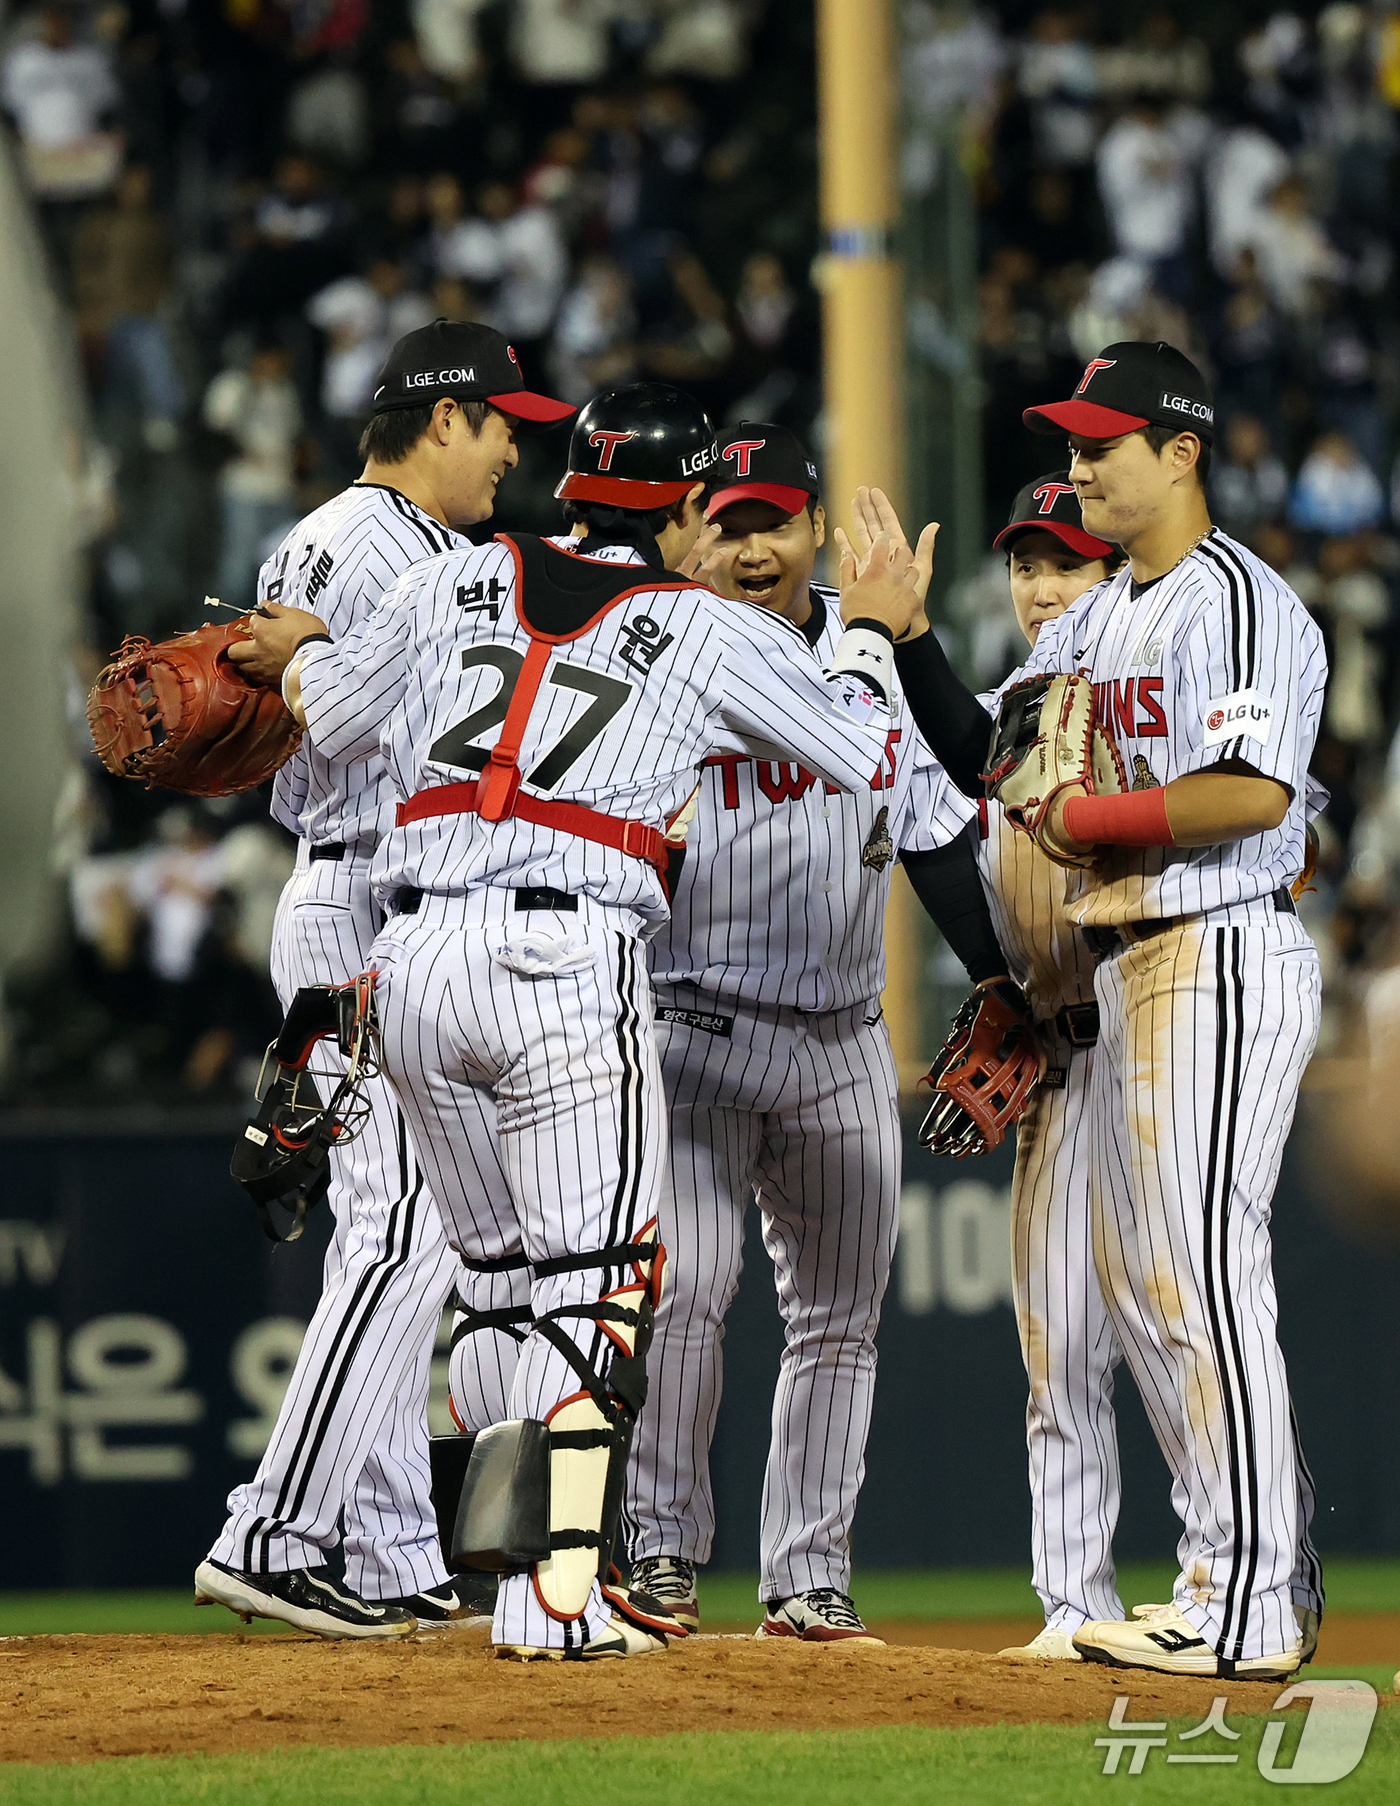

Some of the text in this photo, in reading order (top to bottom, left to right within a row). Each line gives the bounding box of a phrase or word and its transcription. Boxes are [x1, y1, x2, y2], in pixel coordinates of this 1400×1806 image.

[405, 367, 476, 389] LGE.COM
[1162, 393, 1214, 423] LGE.COM
[588, 430, 638, 471] T
[721, 439, 766, 477] T
[425, 641, 638, 793] 27
[1226, 704, 1248, 723] LG
[899, 1180, 1012, 1317] 10
